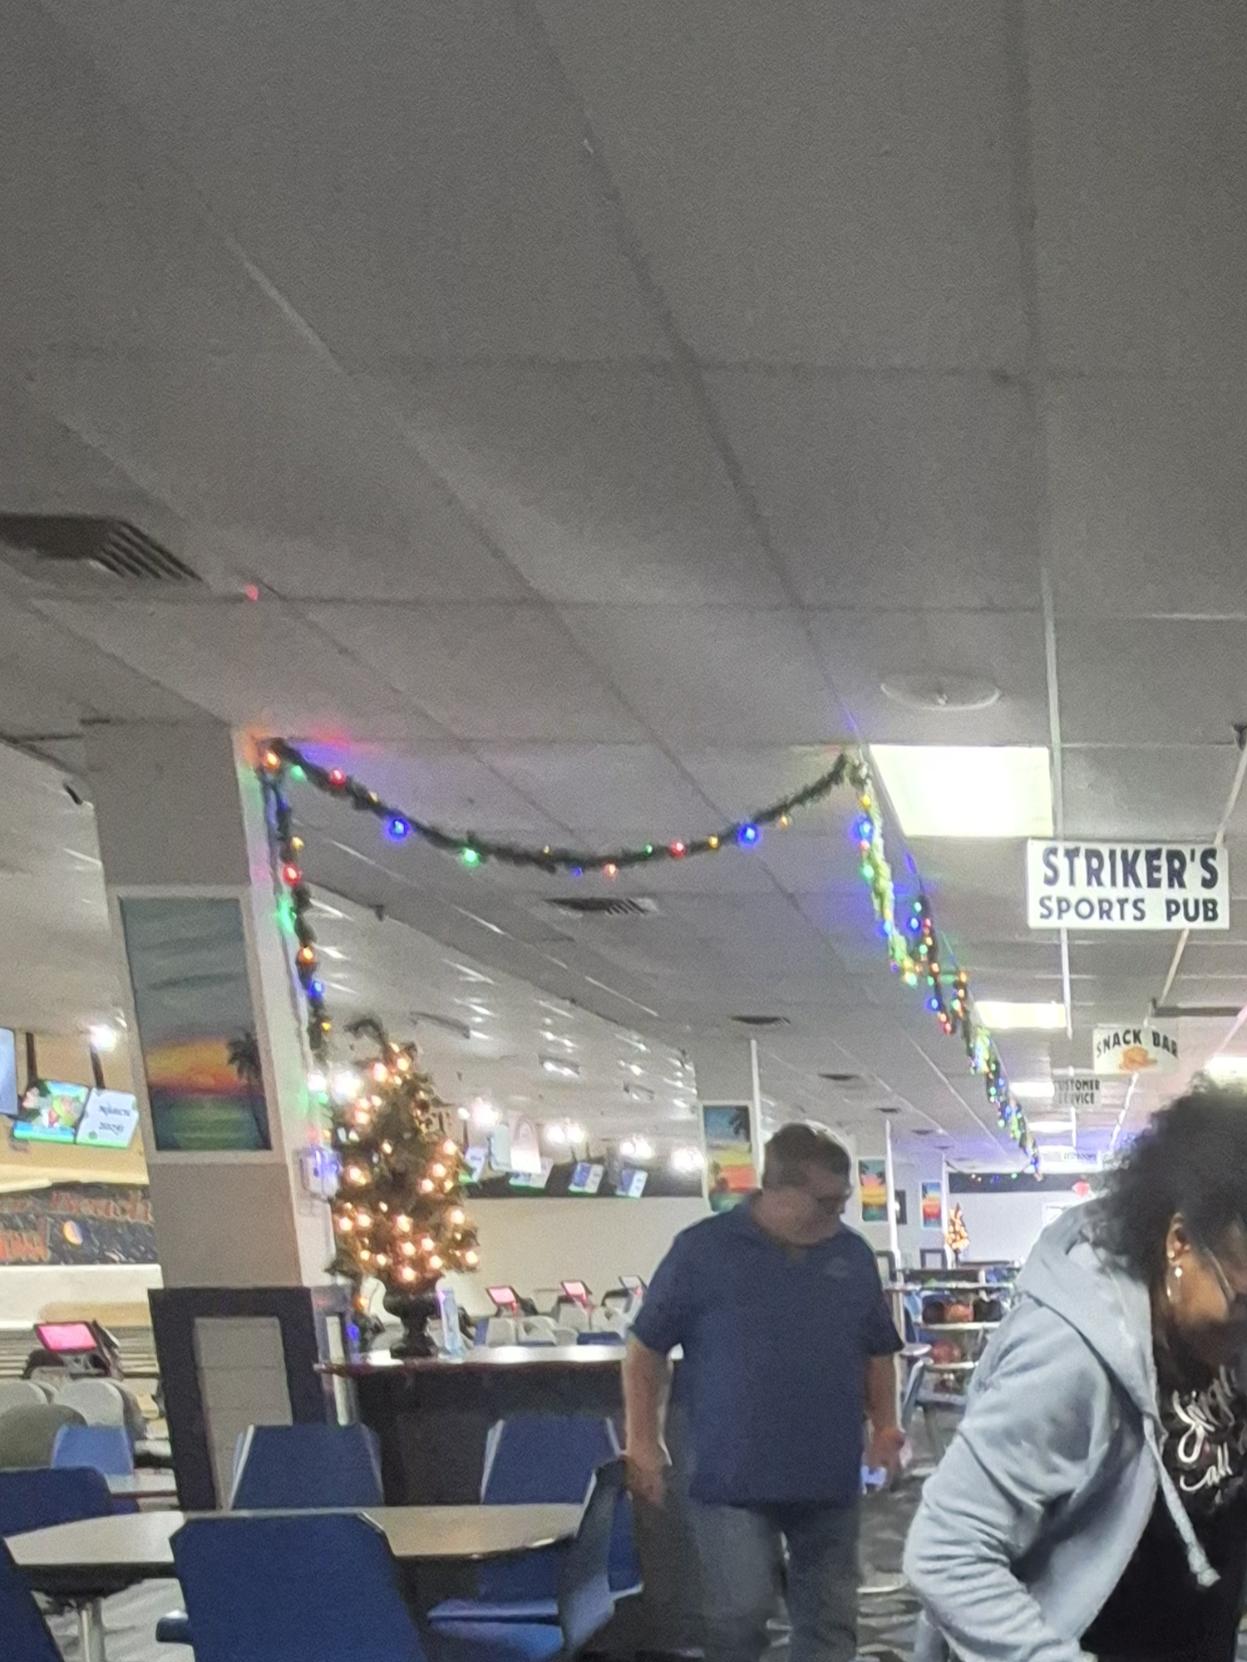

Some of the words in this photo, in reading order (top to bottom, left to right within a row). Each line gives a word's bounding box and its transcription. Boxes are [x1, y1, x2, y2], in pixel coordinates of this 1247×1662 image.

[1042, 846, 1219, 889] STRIKER'S
[1039, 896, 1146, 921] SPORTS
[1165, 897, 1219, 922] PUB
[1097, 1029, 1142, 1058] SNACK
[1152, 1030, 1177, 1057] BAR
